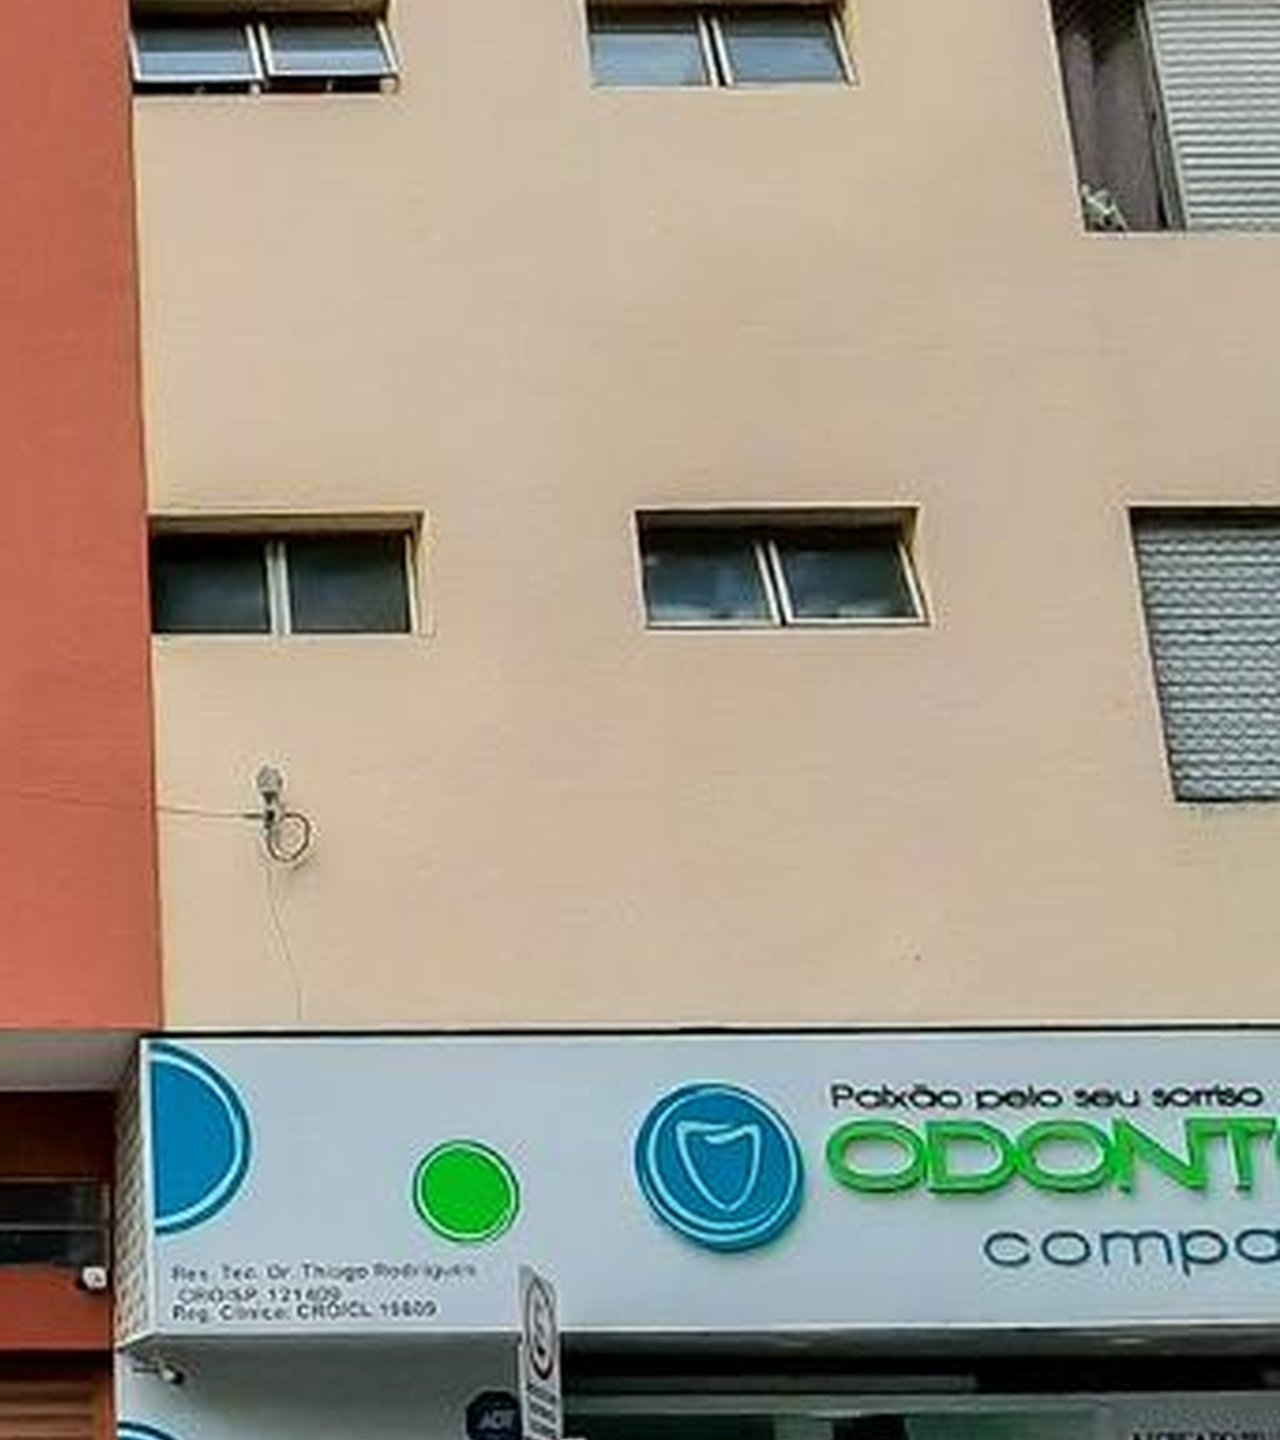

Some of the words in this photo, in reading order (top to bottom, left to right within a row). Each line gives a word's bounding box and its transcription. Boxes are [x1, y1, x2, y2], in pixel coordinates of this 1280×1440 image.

[830, 1084, 962, 1110] Paixão
[975, 1086, 1062, 1110] pelo
[1073, 1088, 1139, 1108] seu
[1151, 1086, 1264, 1108] sorriso
[824, 1118, 1280, 1194] ODONT
